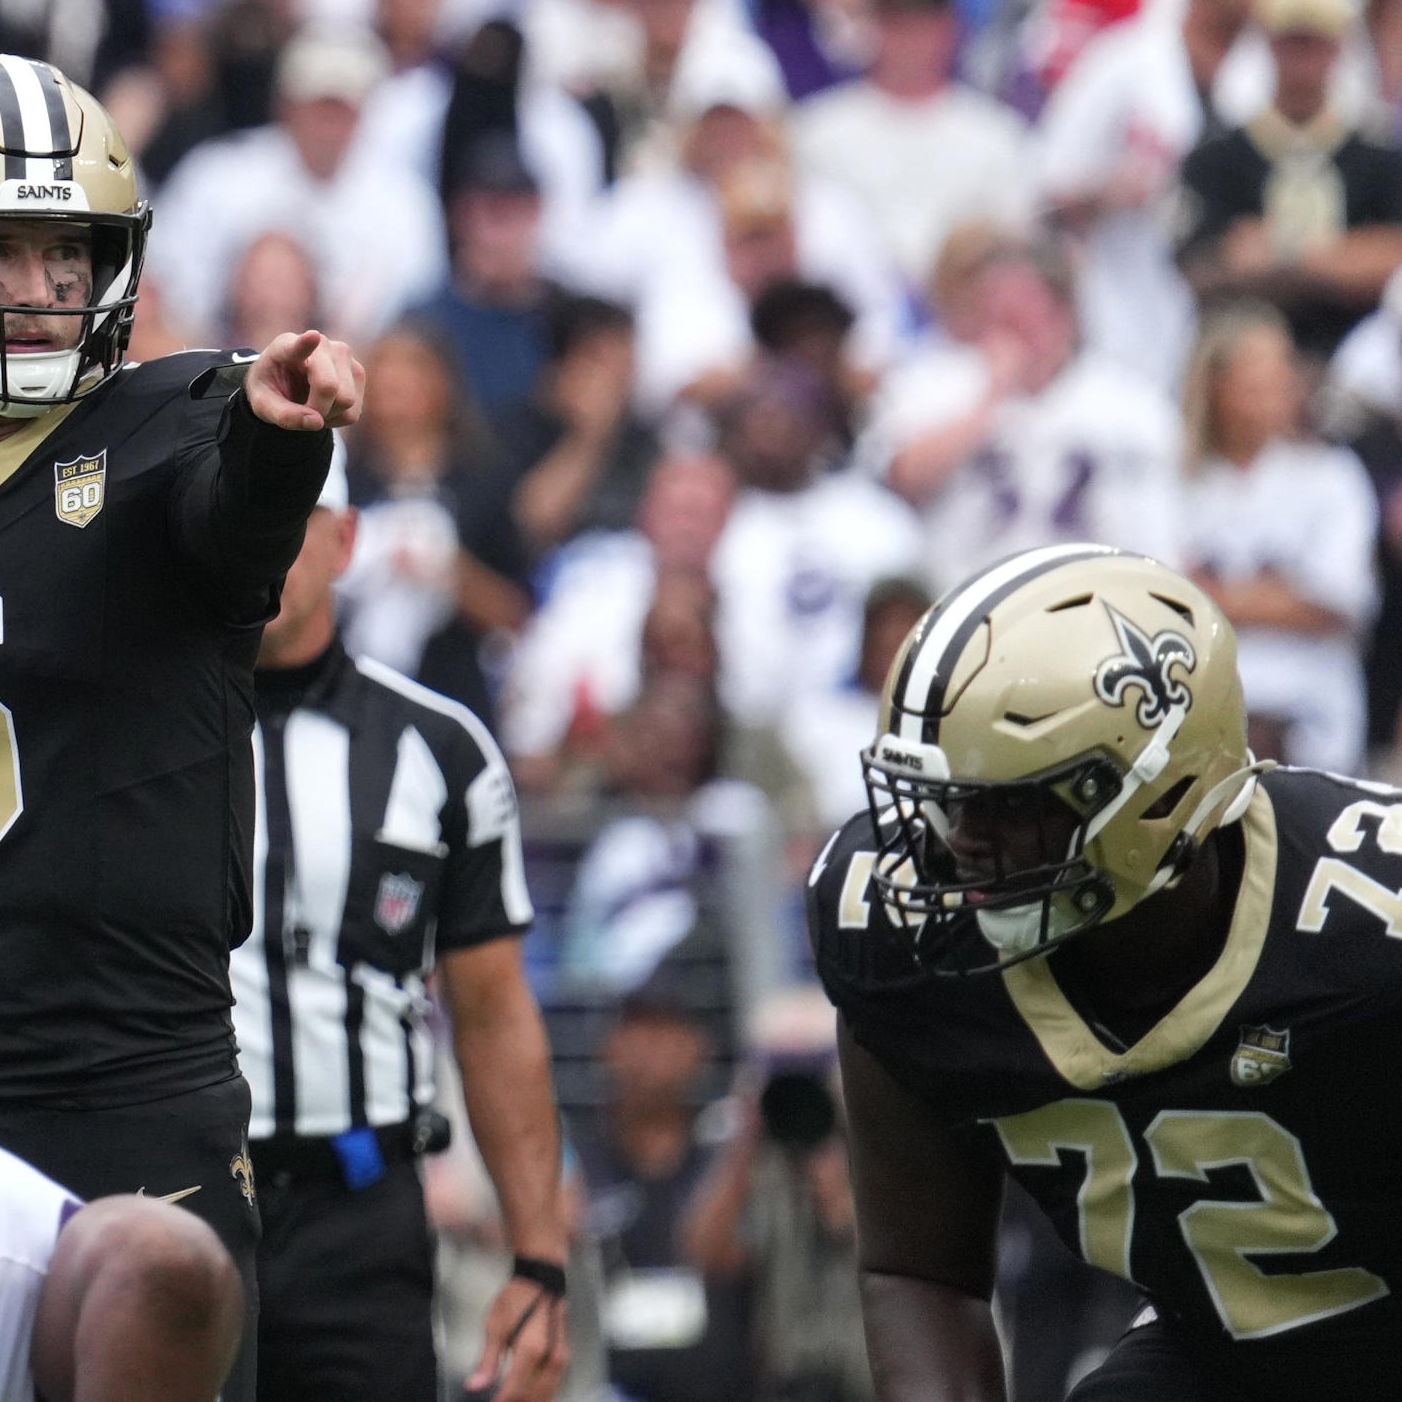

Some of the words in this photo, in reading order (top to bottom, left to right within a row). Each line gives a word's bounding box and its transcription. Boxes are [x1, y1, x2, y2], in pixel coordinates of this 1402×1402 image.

[17, 185, 72, 201] SAINTS
[62, 466, 77, 478] EST
[80, 460, 100, 473] 1967
[61, 482, 101, 514] 60
[977, 1098, 1391, 1341] 72
